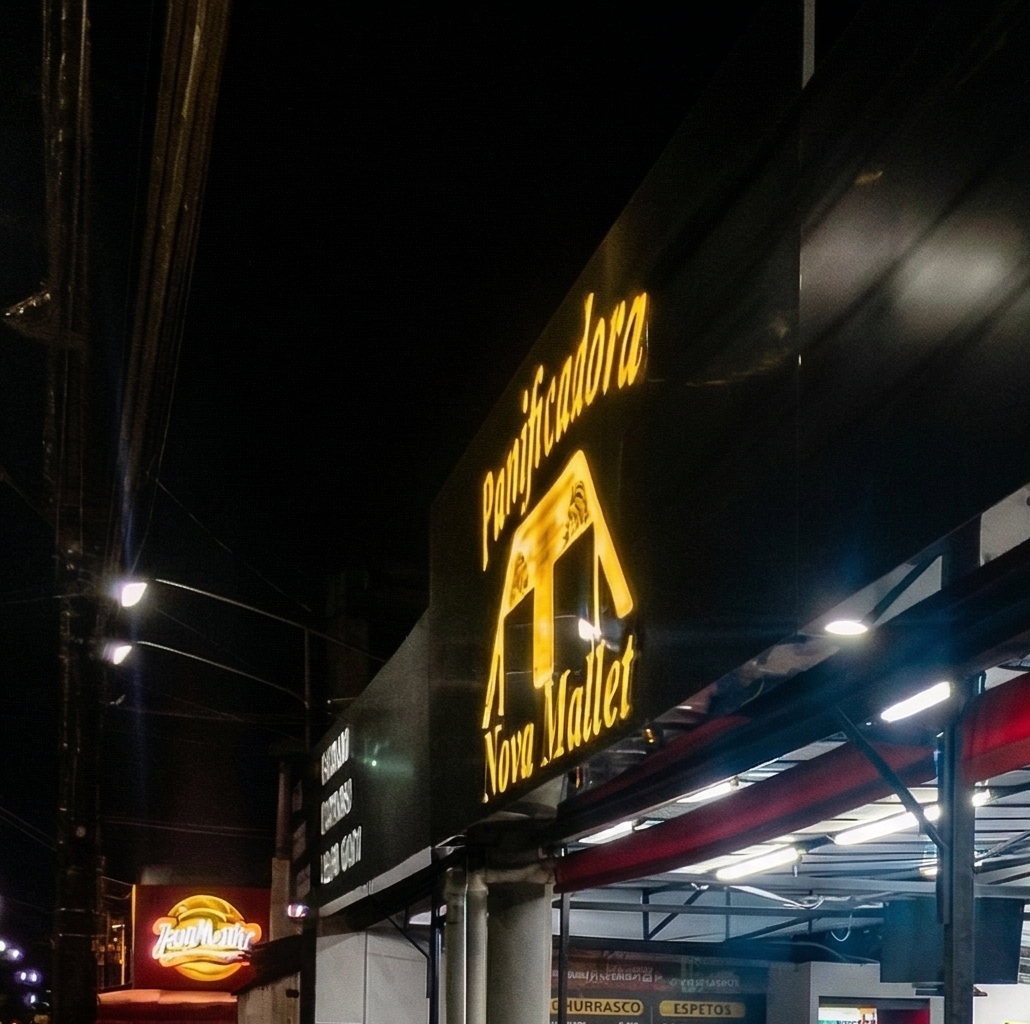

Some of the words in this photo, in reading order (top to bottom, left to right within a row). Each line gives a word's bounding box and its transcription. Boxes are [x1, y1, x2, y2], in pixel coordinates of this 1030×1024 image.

[482, 292, 647, 571] Panificadora
[483, 722, 534, 803] Nova
[540, 634, 635, 767] Mallet
[674, 1003, 732, 1015] ESPETOS
